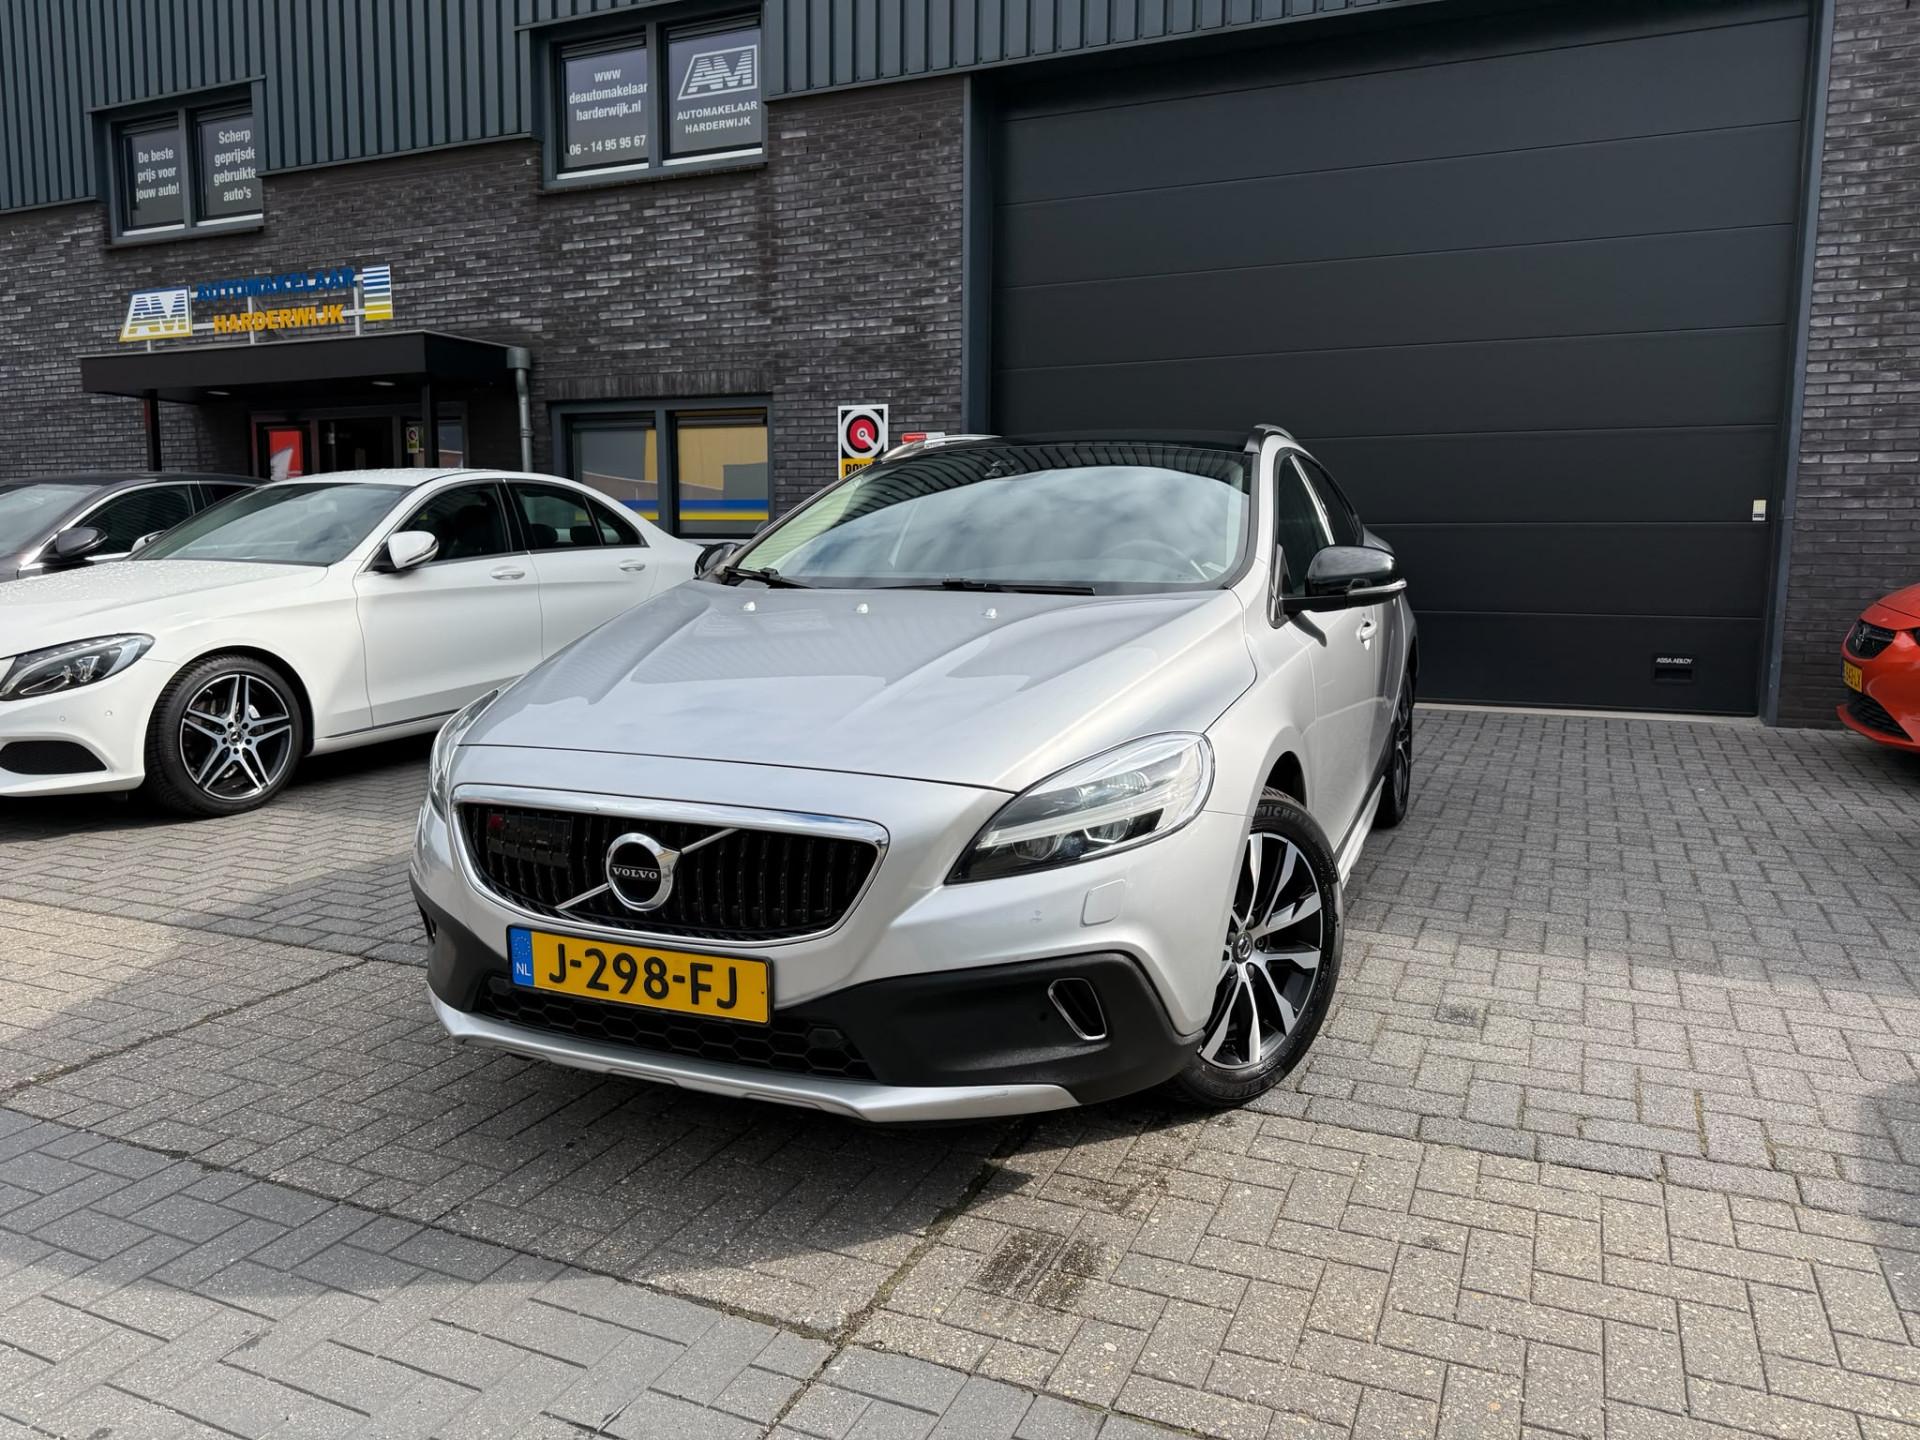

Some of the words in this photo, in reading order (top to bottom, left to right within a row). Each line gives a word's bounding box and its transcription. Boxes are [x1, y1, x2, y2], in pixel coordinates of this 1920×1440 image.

[593, 69, 622, 82] www
[568, 82, 648, 105] deautomakelaar
[576, 99, 642, 121] harderwijk.nl
[676, 100, 758, 121] AUTOMAKELAAR
[684, 116, 751, 134] HARDERWIJK
[218, 129, 251, 145] Scherp
[569, 143, 582, 156] 06
[591, 140, 603, 153] 14
[605, 138, 617, 151] 95
[619, 136, 632, 149] 95
[634, 134, 647, 147] 67
[138, 151, 149, 164] De
[150, 147, 174, 161] beste
[137, 168, 156, 184] prijs
[157, 167, 177, 178] voor
[213, 167, 256, 187] gebruikte
[135, 187, 156, 203] jouw
[158, 182, 180, 197] auto!
[223, 186, 252, 202] auto's
[196, 267, 357, 301] AUTOMAKELAAR
[212, 303, 345, 335] HARDERWIJK
[611, 866, 658, 880] VOLVO
[516, 962, 532, 978] NL
[549, 943, 737, 1010] J-298-FJ
